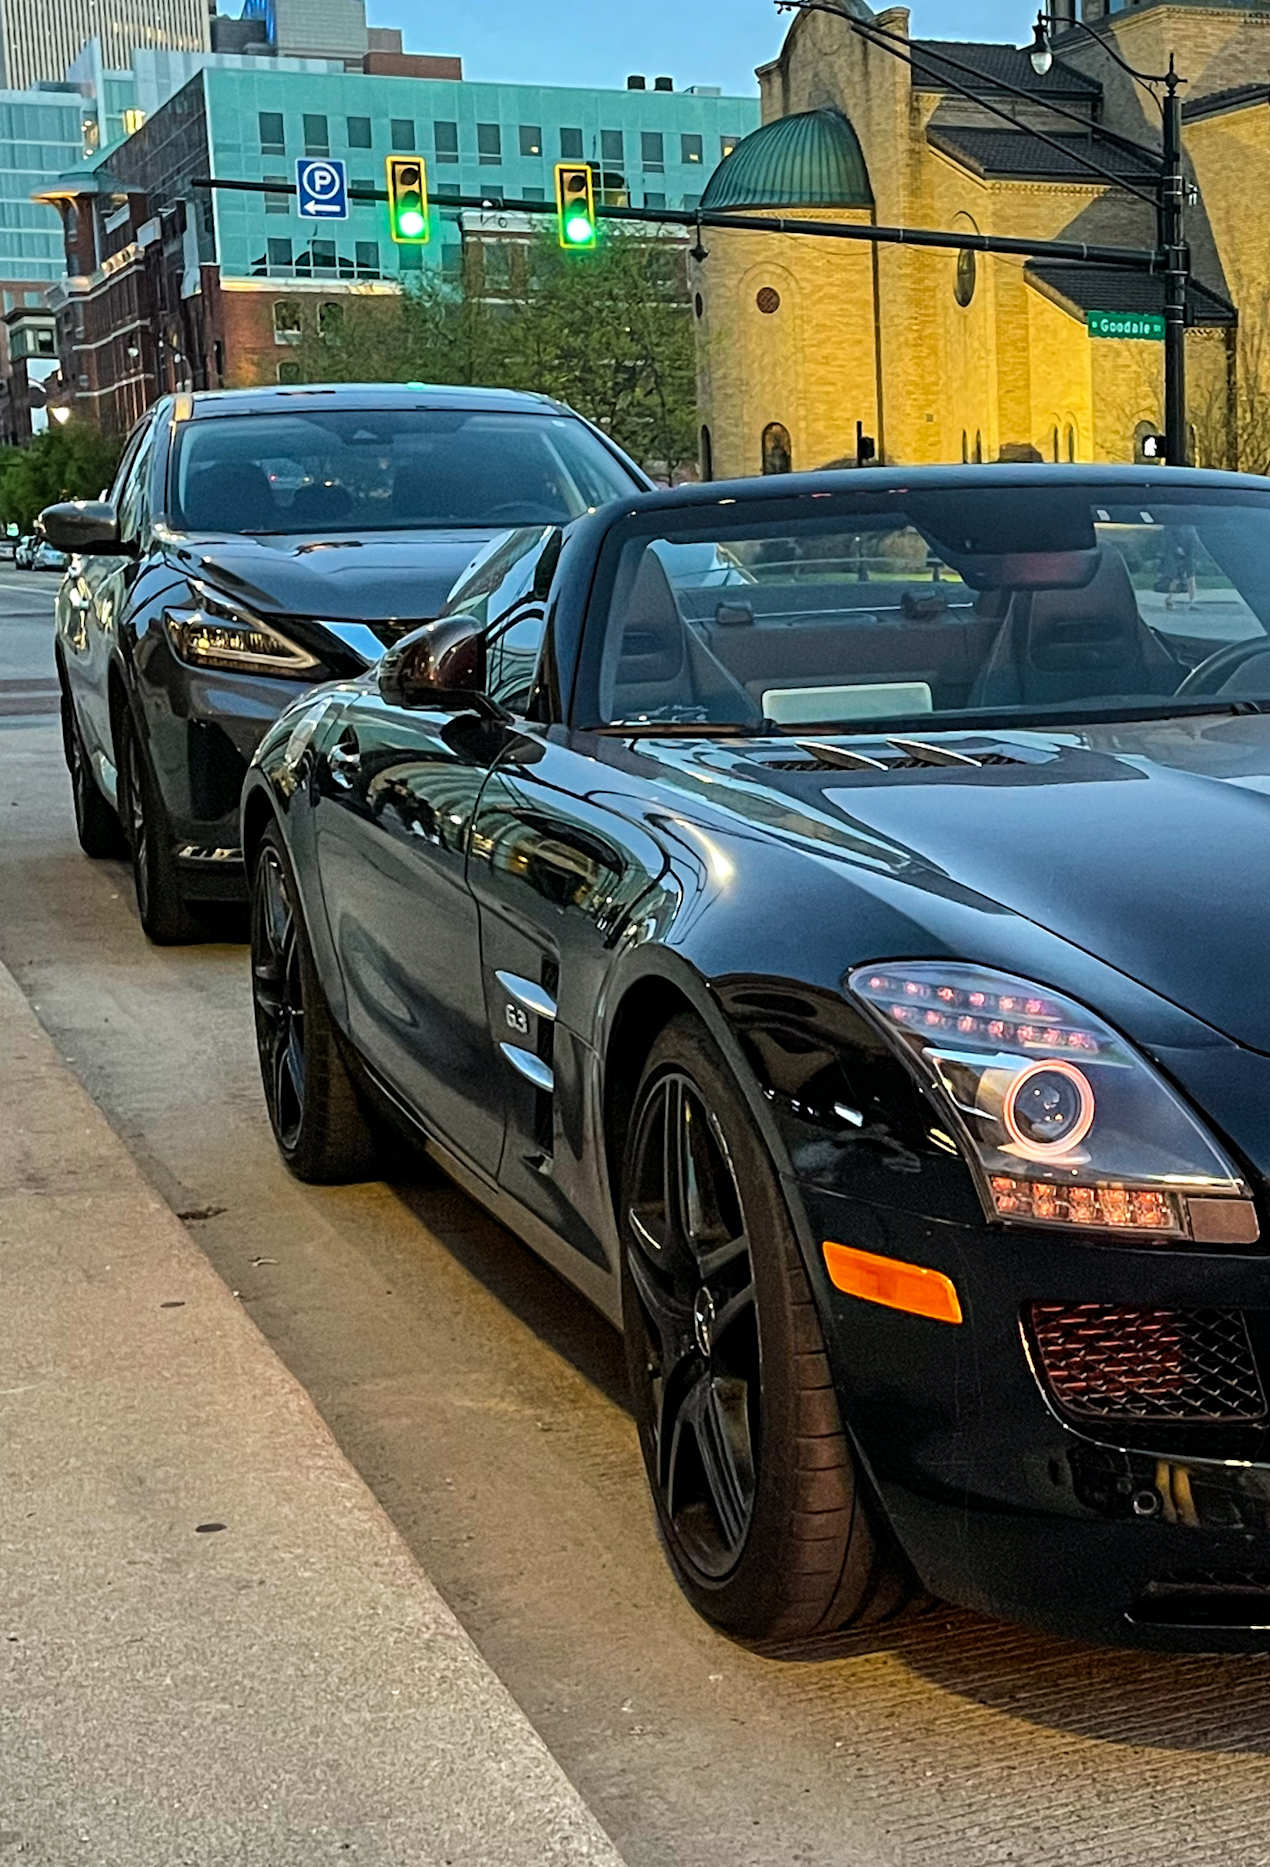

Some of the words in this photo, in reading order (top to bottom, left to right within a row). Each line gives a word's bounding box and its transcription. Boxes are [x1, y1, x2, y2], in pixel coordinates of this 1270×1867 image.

[314, 170, 332, 192] P
[1100, 318, 1151, 335] Goodale
[505, 1003, 528, 1034] 63
